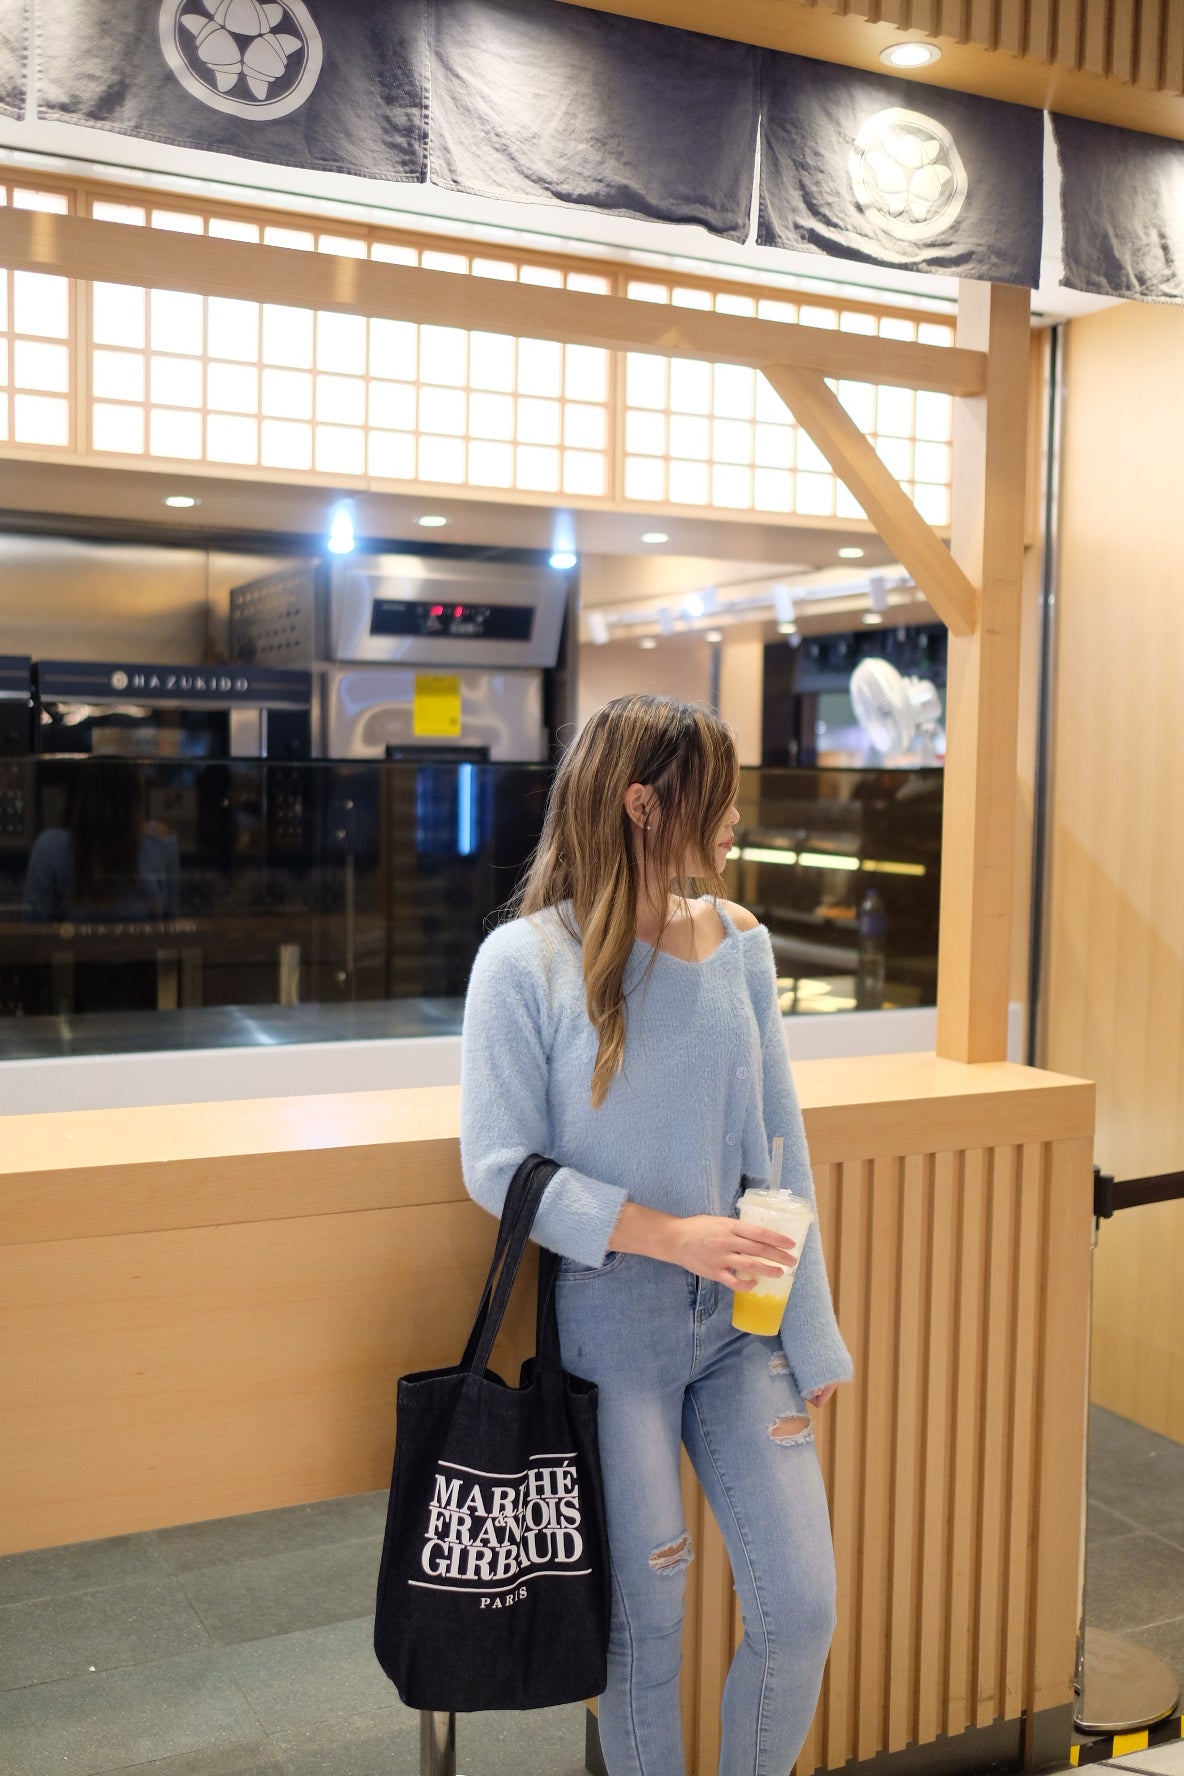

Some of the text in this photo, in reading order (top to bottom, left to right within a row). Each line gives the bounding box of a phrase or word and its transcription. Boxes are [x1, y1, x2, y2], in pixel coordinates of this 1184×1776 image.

[131, 673, 249, 692] HAZUKIDO
[425, 1497, 582, 1547] FRANOIS
[479, 1587, 528, 1609] PARIS
